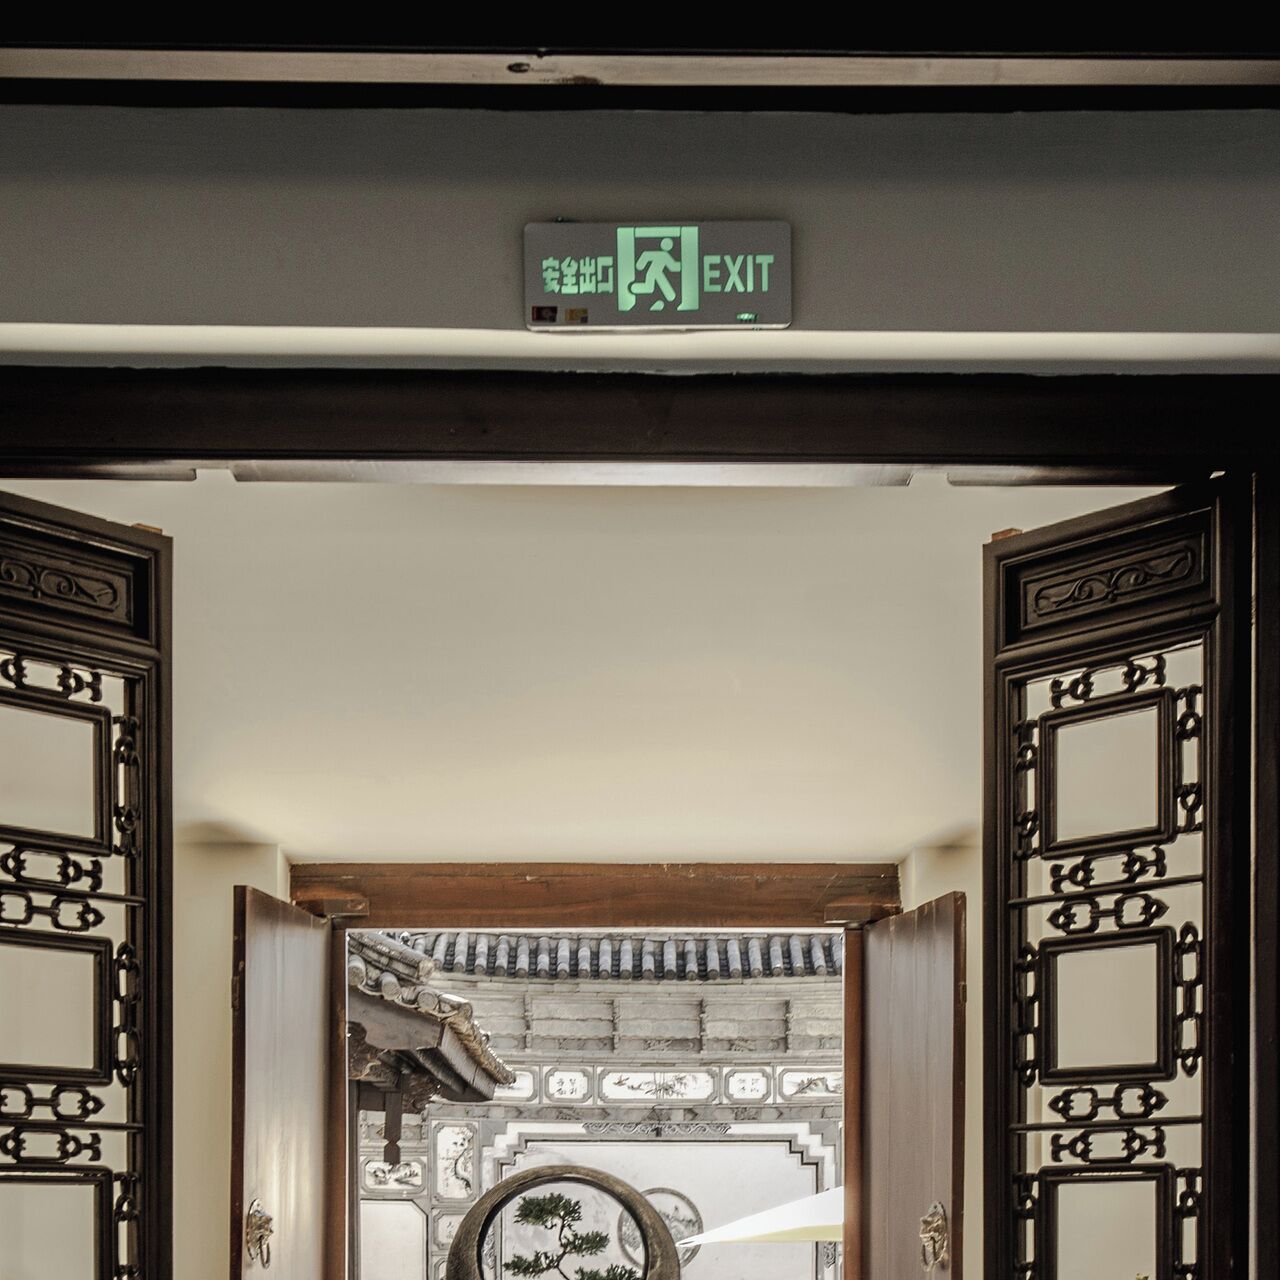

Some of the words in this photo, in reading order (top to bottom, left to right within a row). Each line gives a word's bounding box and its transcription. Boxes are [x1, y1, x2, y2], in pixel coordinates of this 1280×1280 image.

[541, 256, 614, 295] 安全出口
[703, 254, 775, 293] EXIT
